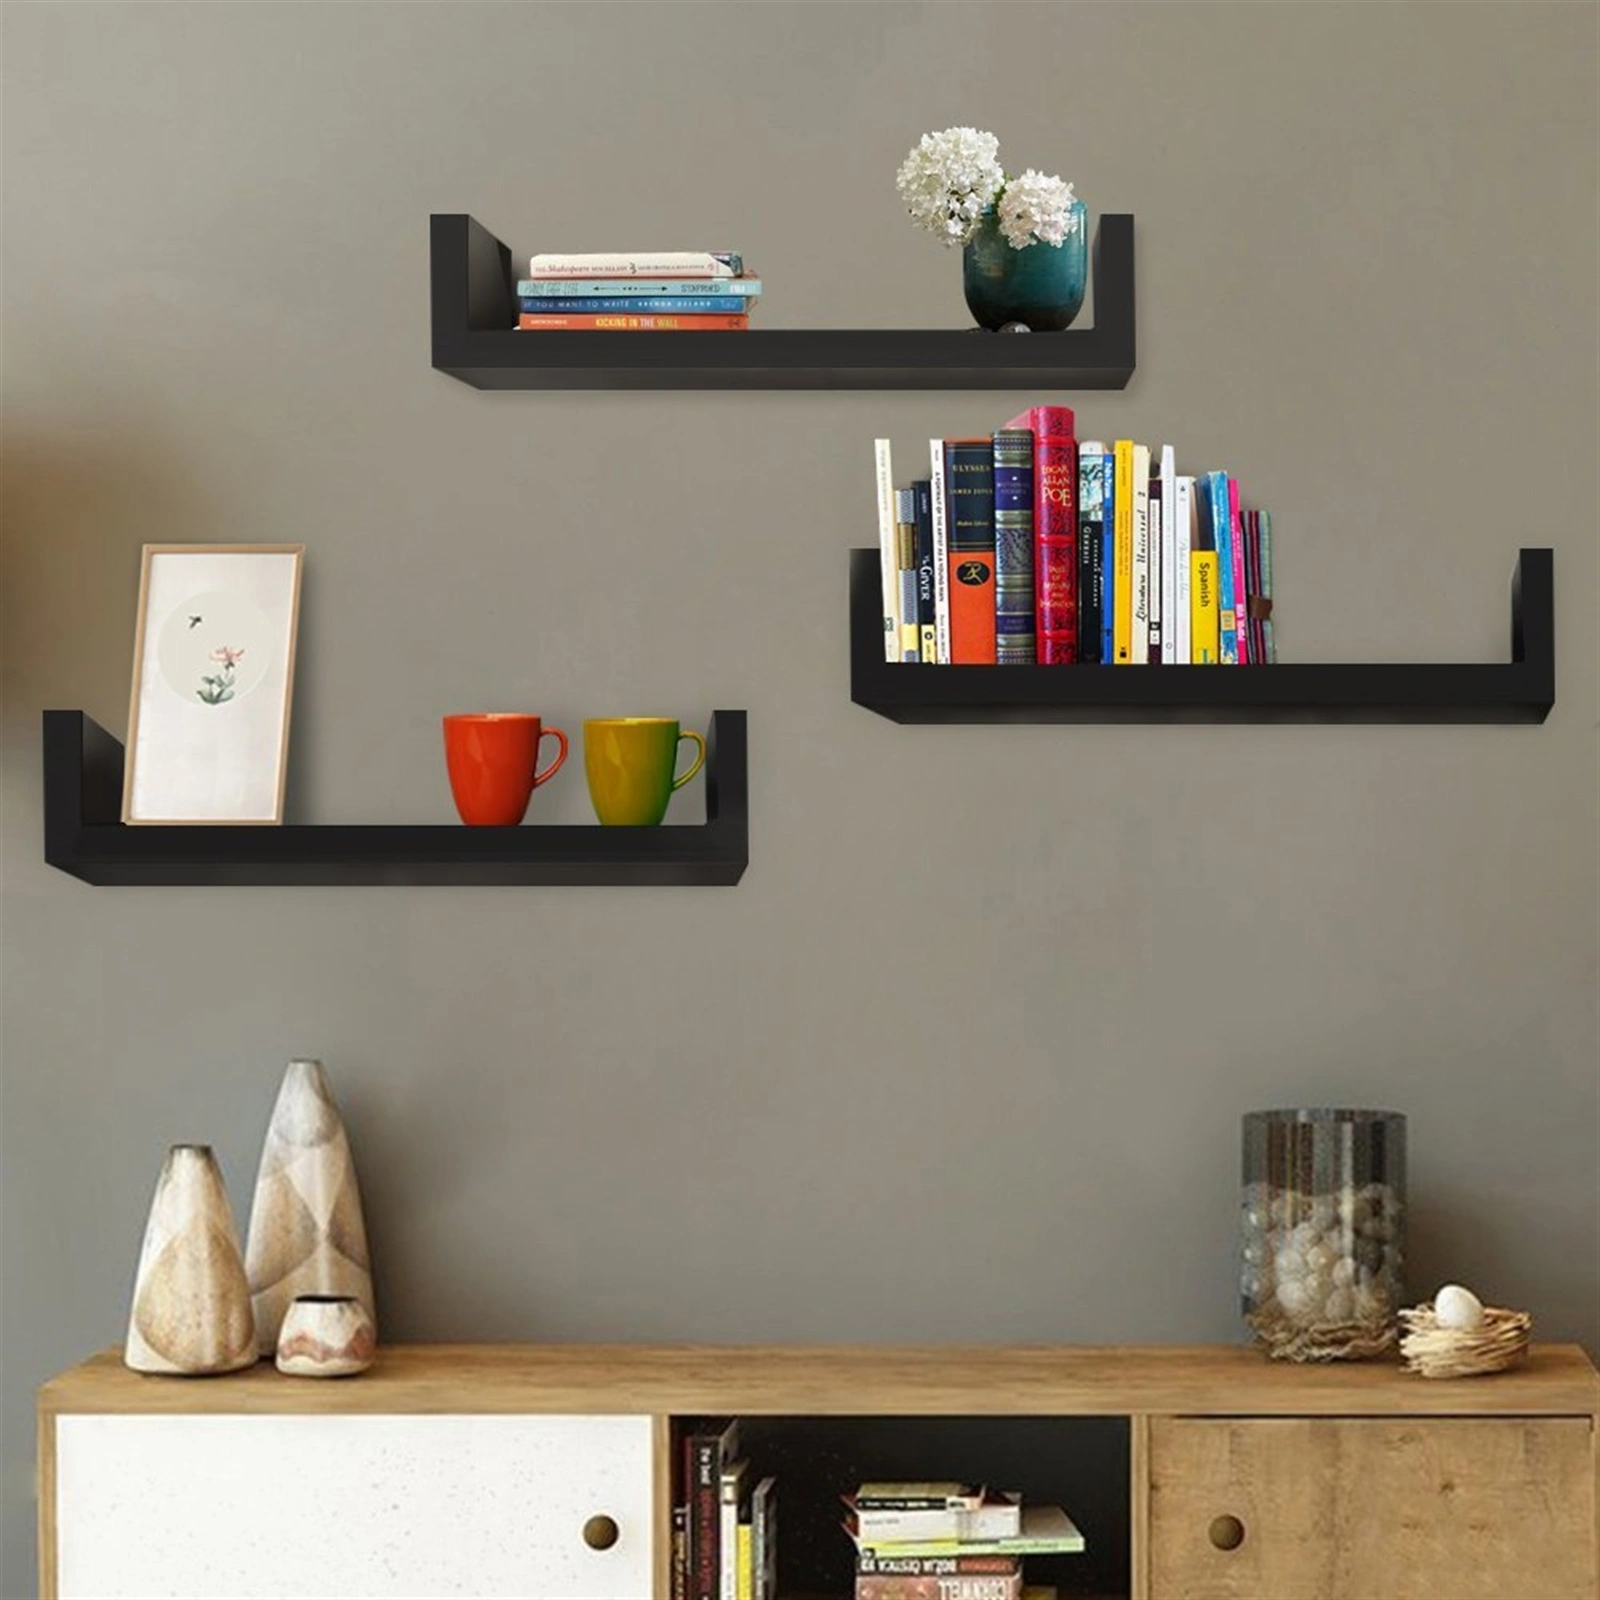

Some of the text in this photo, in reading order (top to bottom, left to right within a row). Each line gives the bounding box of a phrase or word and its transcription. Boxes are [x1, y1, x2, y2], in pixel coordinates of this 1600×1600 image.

[595, 318, 678, 327] KICKING IN THE WALL
[1041, 465, 1069, 475] EDGAR
[1043, 476, 1070, 487] ALLAN
[1041, 487, 1072, 507] POE
[936, 506, 943, 515] OF
[1136, 509, 1147, 563] Universal
[920, 565, 934, 601] GIVER
[1197, 562, 1211, 607] Spanish
